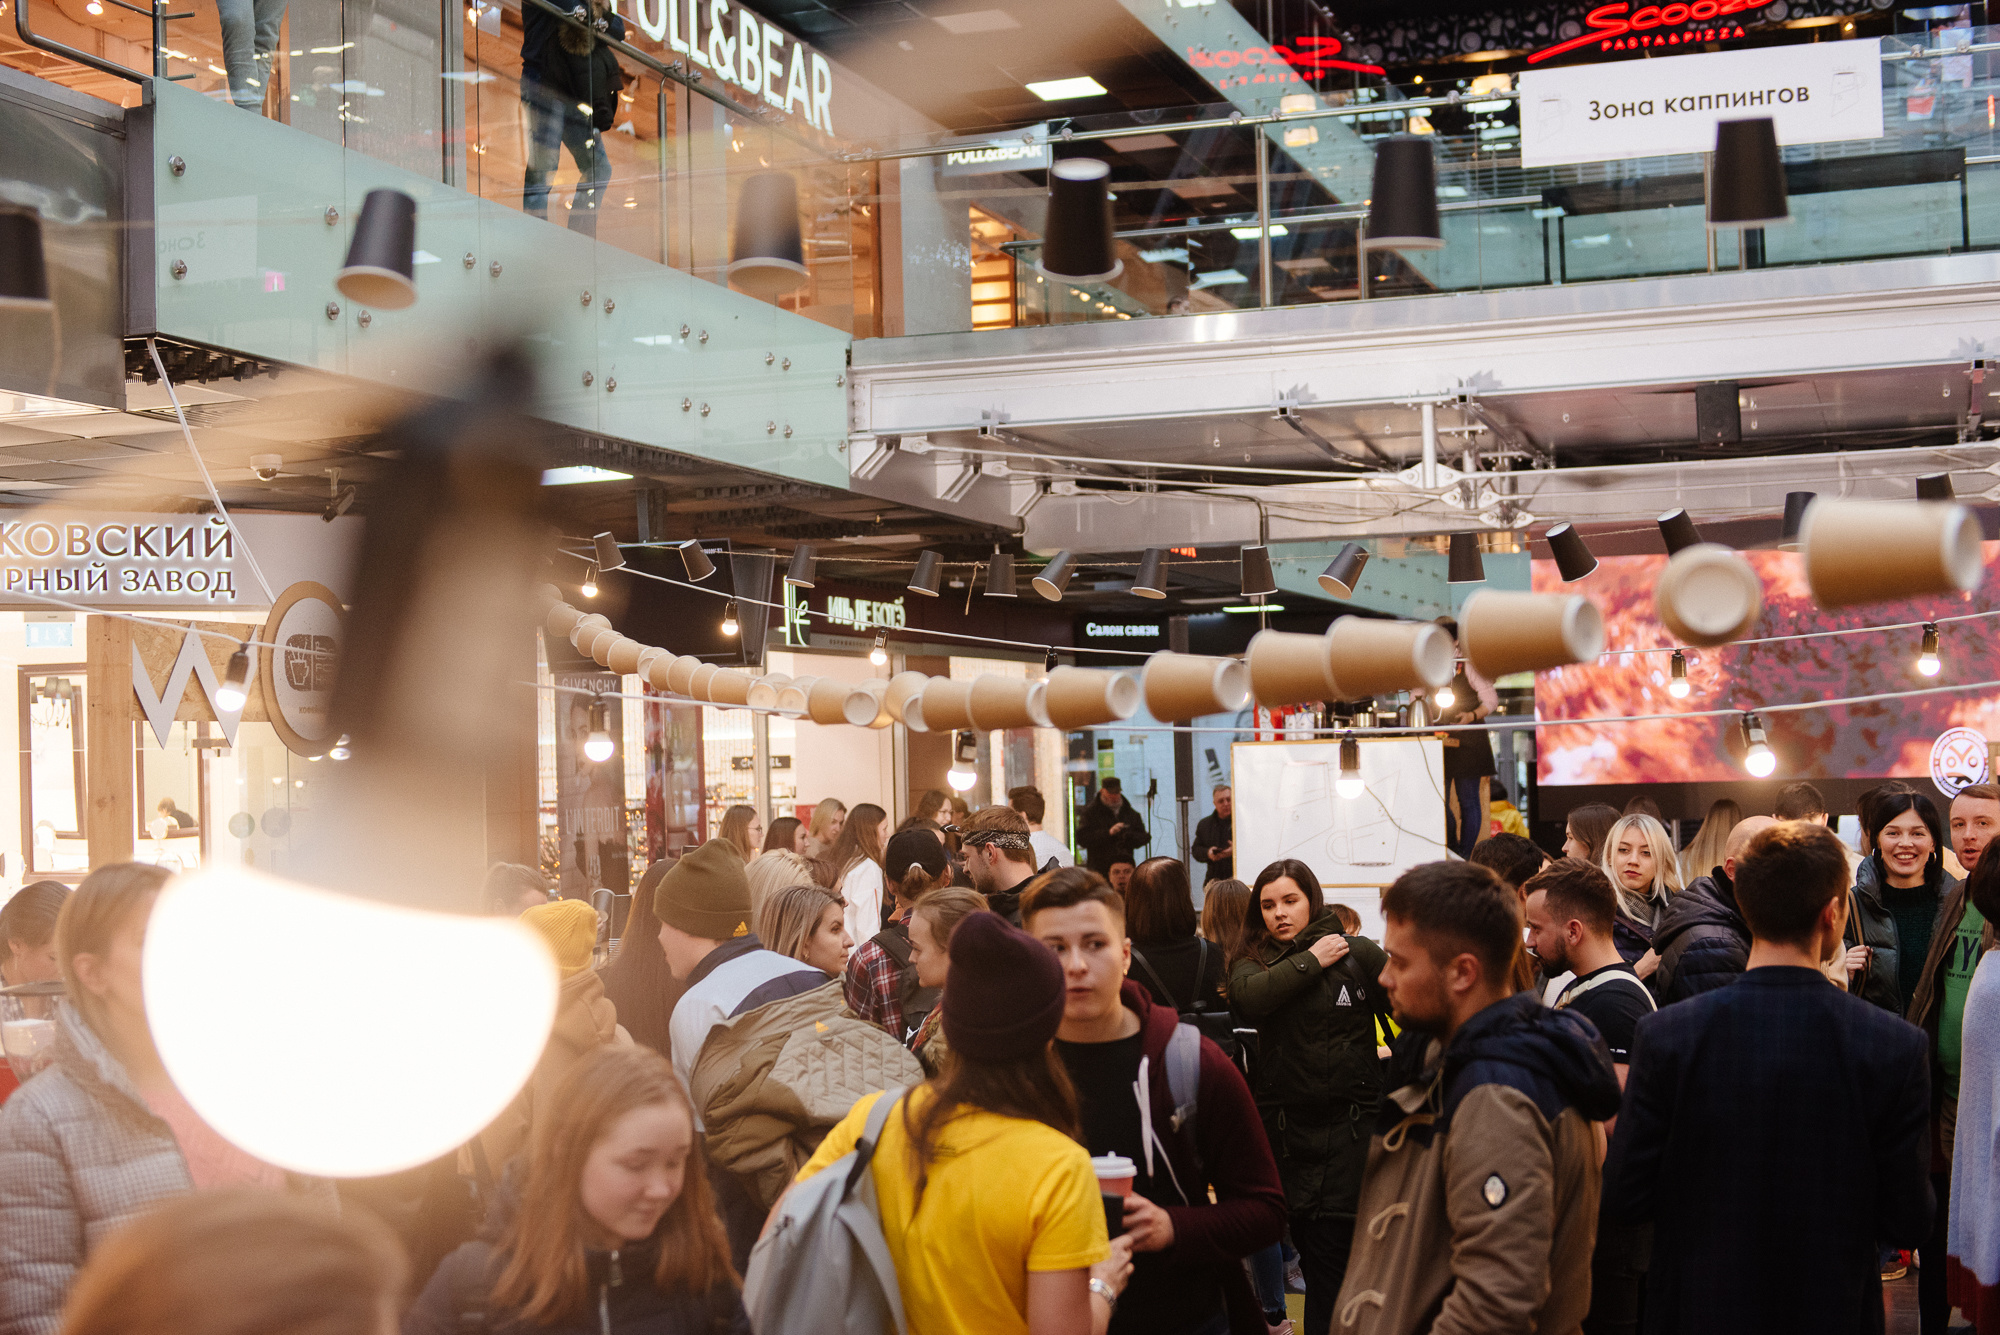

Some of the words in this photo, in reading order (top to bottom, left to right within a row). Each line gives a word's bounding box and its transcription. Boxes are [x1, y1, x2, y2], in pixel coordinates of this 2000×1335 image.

[604, 0, 835, 137] ULL&BEAR
[1588, 100, 1654, 121] Зона
[1664, 86, 1811, 113] каппингов
[0, 516, 234, 559] КОВСКИЙ
[5, 561, 109, 592] РНЫЙ
[121, 568, 237, 600] ЗАВОД
[827, 595, 855, 626] ИЛЬ
[853, 598, 872, 631] ДЕ
[1086, 622, 1125, 637] Салон
[1124, 625, 1160, 637] связи
[561, 677, 618, 693] GIVENCHY
[740, 757, 783, 768] CHEL
[565, 805, 621, 837] L'INTERDIT
